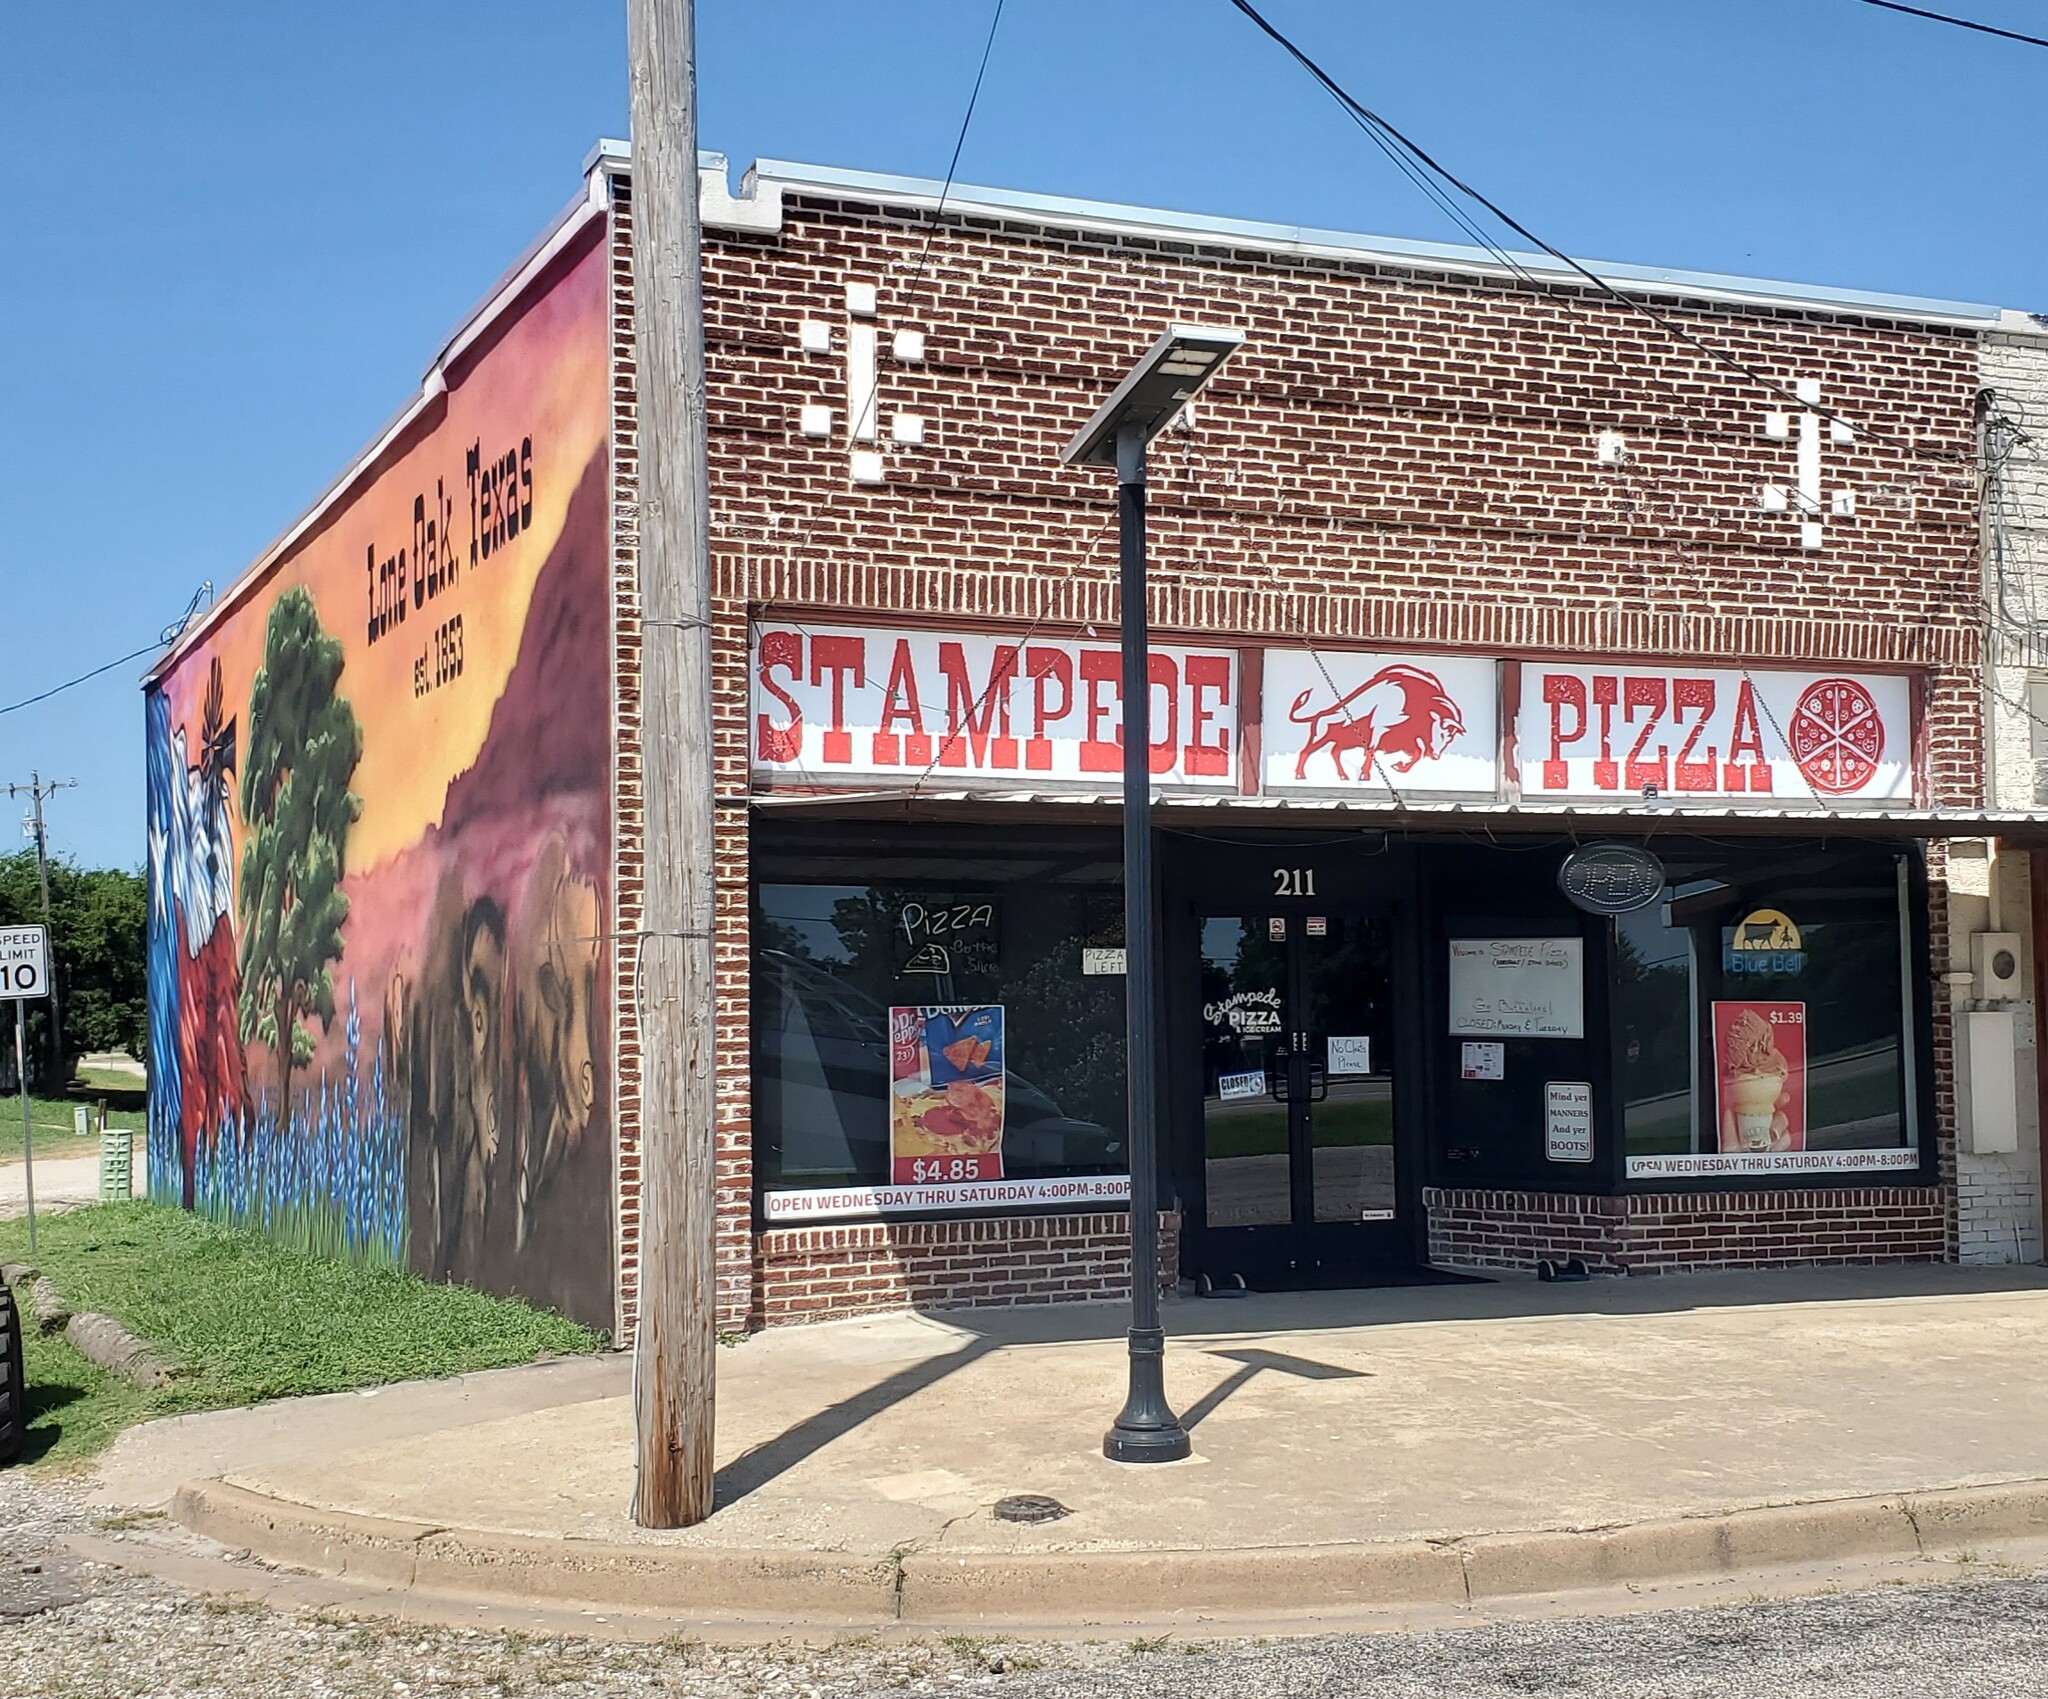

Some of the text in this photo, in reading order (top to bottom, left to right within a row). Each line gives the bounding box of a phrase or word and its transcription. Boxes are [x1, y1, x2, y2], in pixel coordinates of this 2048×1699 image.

[367, 543, 407, 647] Lone
[466, 433, 534, 570] Texas
[434, 612, 464, 688] 1853
[757, 630, 1231, 777] STAMPEDE
[1542, 673, 1774, 793] PIZZA
[1273, 868, 1316, 896] 211
[1566, 862, 1652, 896] OPEN
[0, 933, 41, 945] PEED
[0, 948, 36, 960] LIMIT
[1085, 950, 1124, 961] PIZZA
[1731, 953, 1802, 972] Blue Bell
[1094, 962, 1124, 973] LEFT
[0, 963, 37, 990] 10
[1229, 1011, 1281, 1026] PIZZA
[1769, 1010, 1804, 1024] $1.39
[1332, 1039, 1344, 1054] No
[1550, 1092, 1588, 1103] Mind yer
[1550, 1109, 1589, 1118] MANNERS
[1552, 1124, 1587, 1136] And yer
[1550, 1141, 1590, 1152] BOOTS!
[912, 1158, 980, 1184] $4.85
[1664, 1158, 1738, 1172] WEDNESDAY
[1741, 1158, 1771, 1170] THRU
[1774, 1156, 1833, 1169] SATURDAY
[1836, 1153, 1918, 1167] 4:00PM-8:00PM
[770, 1181, 1131, 1212] OPEN WEDNESDAY THRU SATURDAY 4:00PM-8:00P
